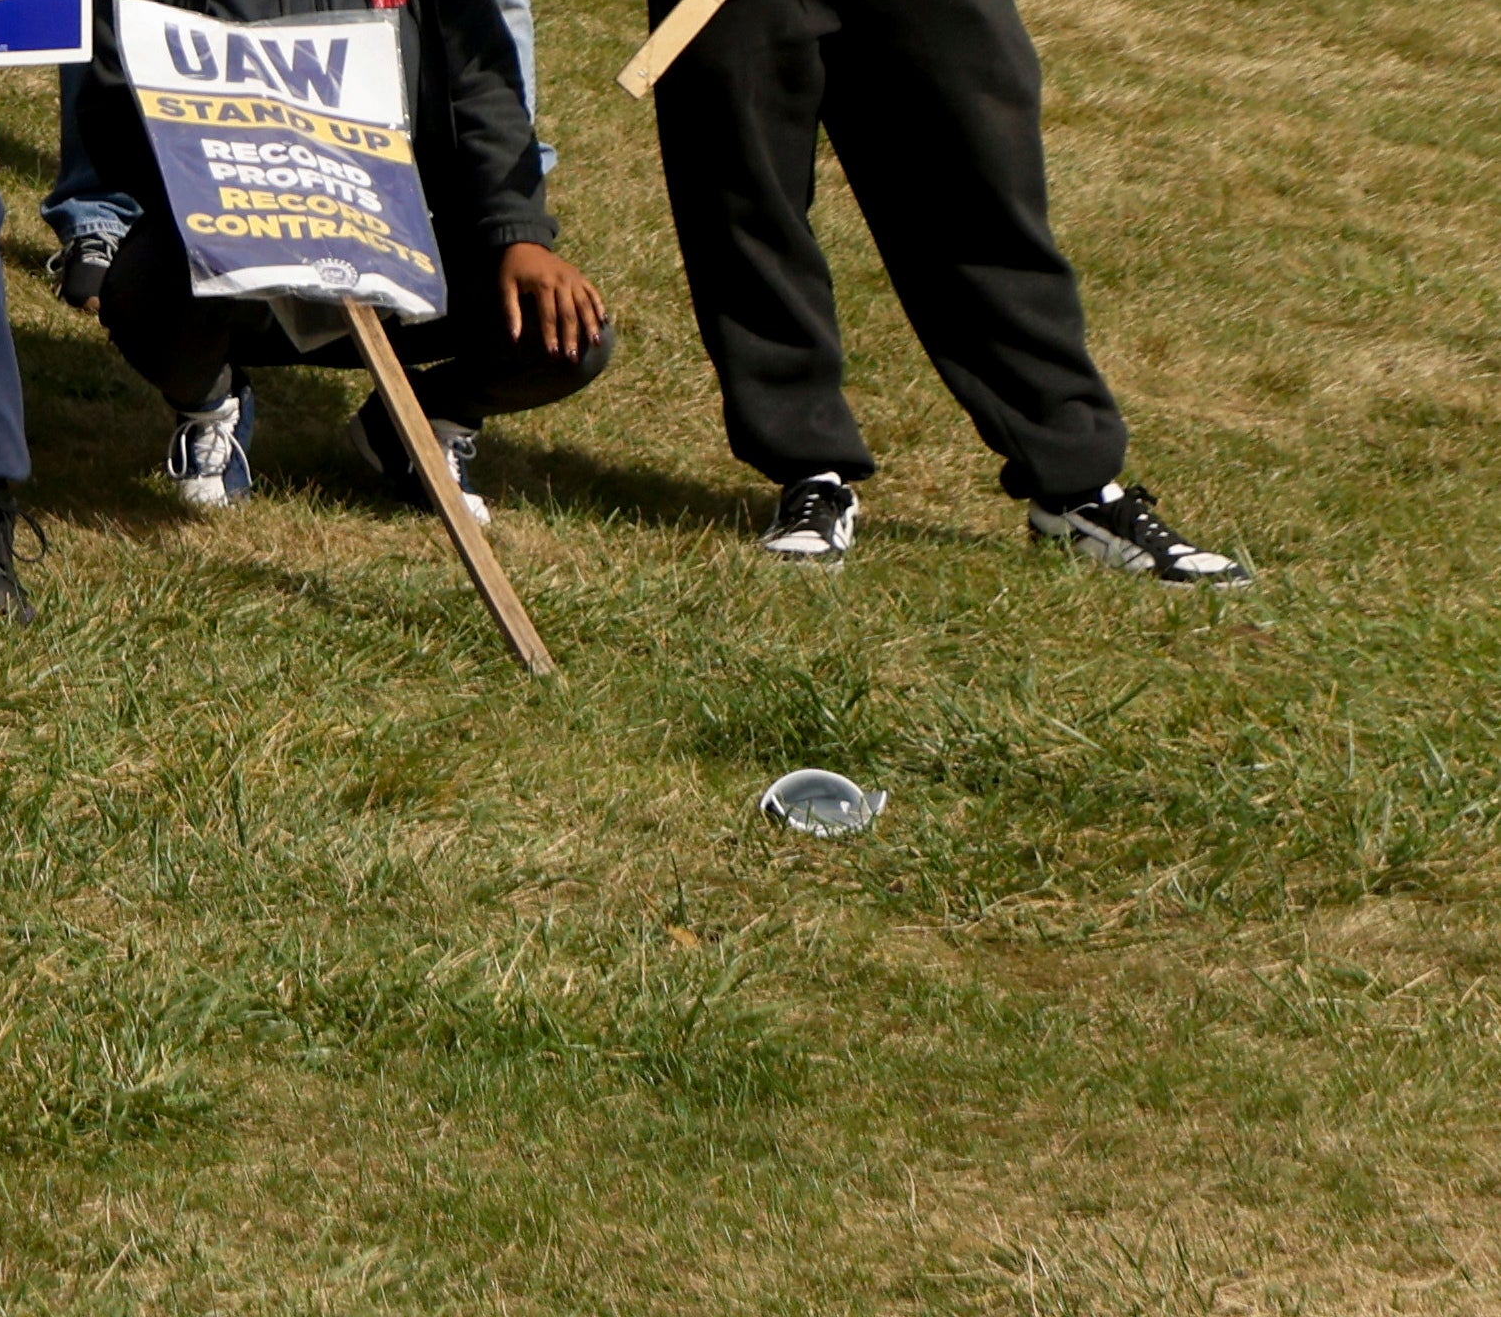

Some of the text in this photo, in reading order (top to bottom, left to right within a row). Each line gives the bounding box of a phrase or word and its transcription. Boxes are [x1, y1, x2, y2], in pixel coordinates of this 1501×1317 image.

[164, 21, 349, 109] UAW
[155, 96, 392, 150] STAND UP
[200, 138, 372, 187] RECORD
[208, 162, 383, 214] PROFITS
[219, 186, 392, 236] RECORD
[186, 212, 437, 275] CONTRACTS
